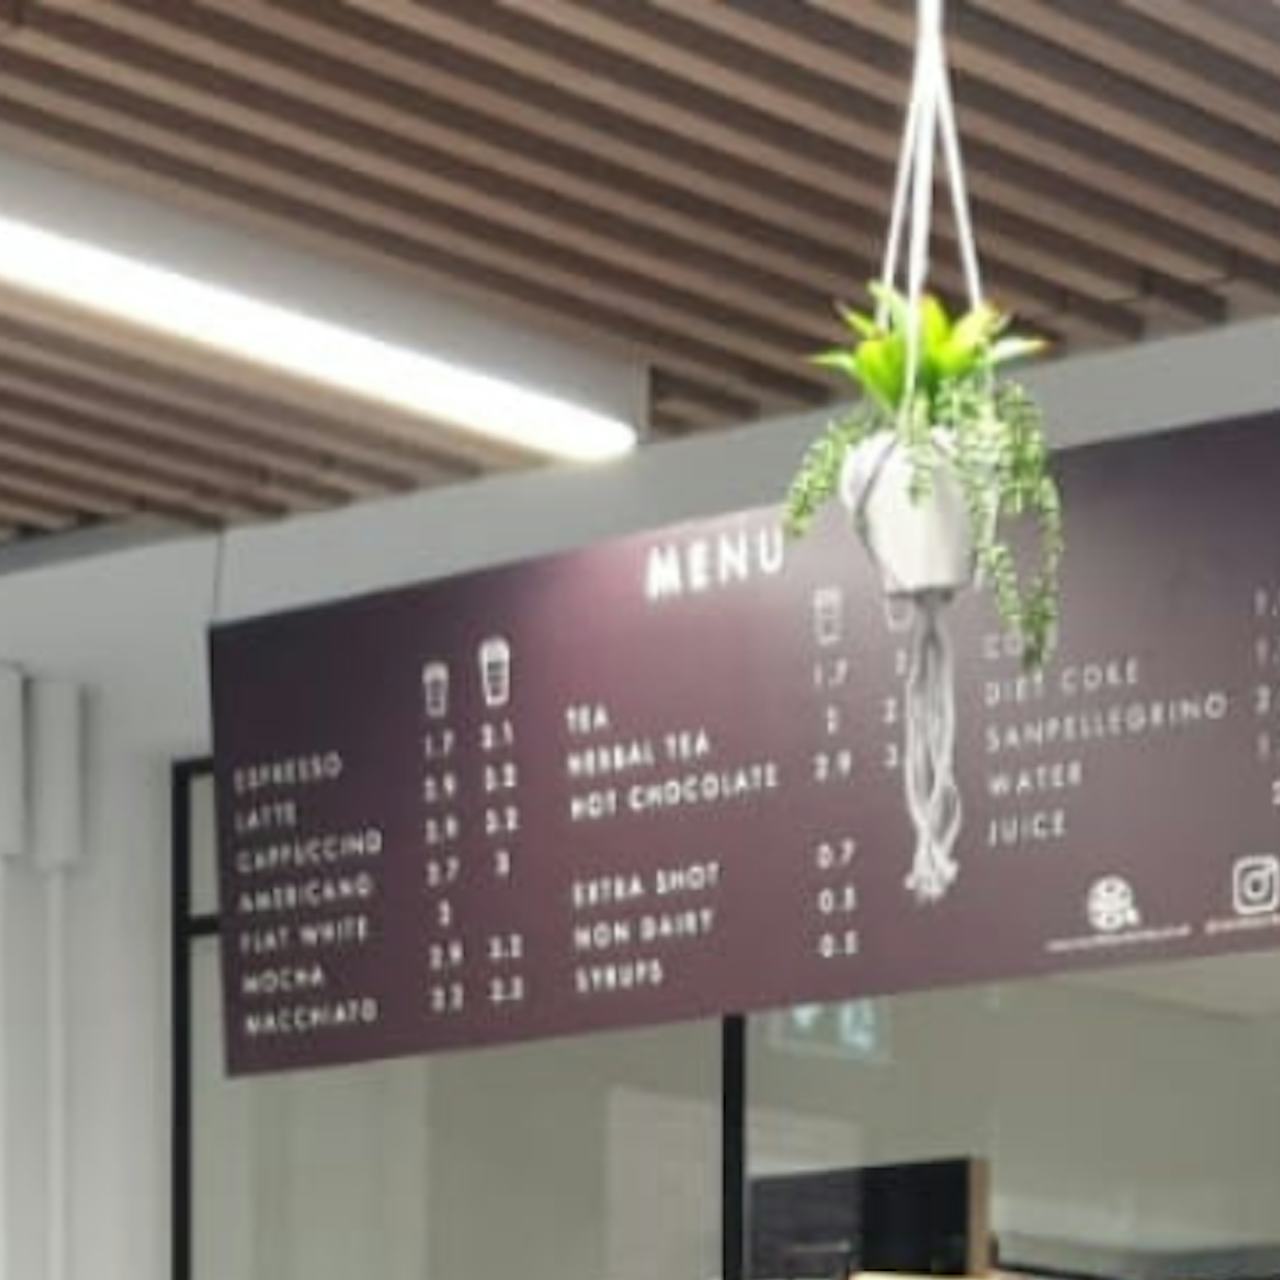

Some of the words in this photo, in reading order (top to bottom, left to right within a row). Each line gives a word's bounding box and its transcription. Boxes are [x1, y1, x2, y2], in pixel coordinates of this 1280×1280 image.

[645, 523, 784, 603] MENU
[1061, 657, 1139, 692] COKE
[566, 703, 609, 733] TEA
[986, 691, 1228, 754] SANPELLEGRINO
[568, 738, 654, 777] HERBAL
[665, 727, 709, 762] TEA
[233, 750, 342, 795] ESPRESSO
[571, 787, 618, 823] HOT
[628, 762, 779, 812] CHOCOLATE
[988, 759, 1082, 796] WATER
[233, 800, 296, 834] LATTE
[988, 808, 1065, 847] JUICE
[235, 827, 383, 875] CAPPUCCINO
[239, 871, 374, 911] AMERICANO
[573, 872, 645, 909] EXTRA
[655, 861, 720, 894] SHOT
[240, 925, 289, 955] FLAT
[300, 914, 367, 946] WHITE
[575, 921, 631, 950] NON
[640, 908, 713, 941] DAIRY
[243, 963, 323, 993] MOCHA
[575, 957, 663, 994] SYRUPS
[246, 998, 378, 1036] MACCHIATO
